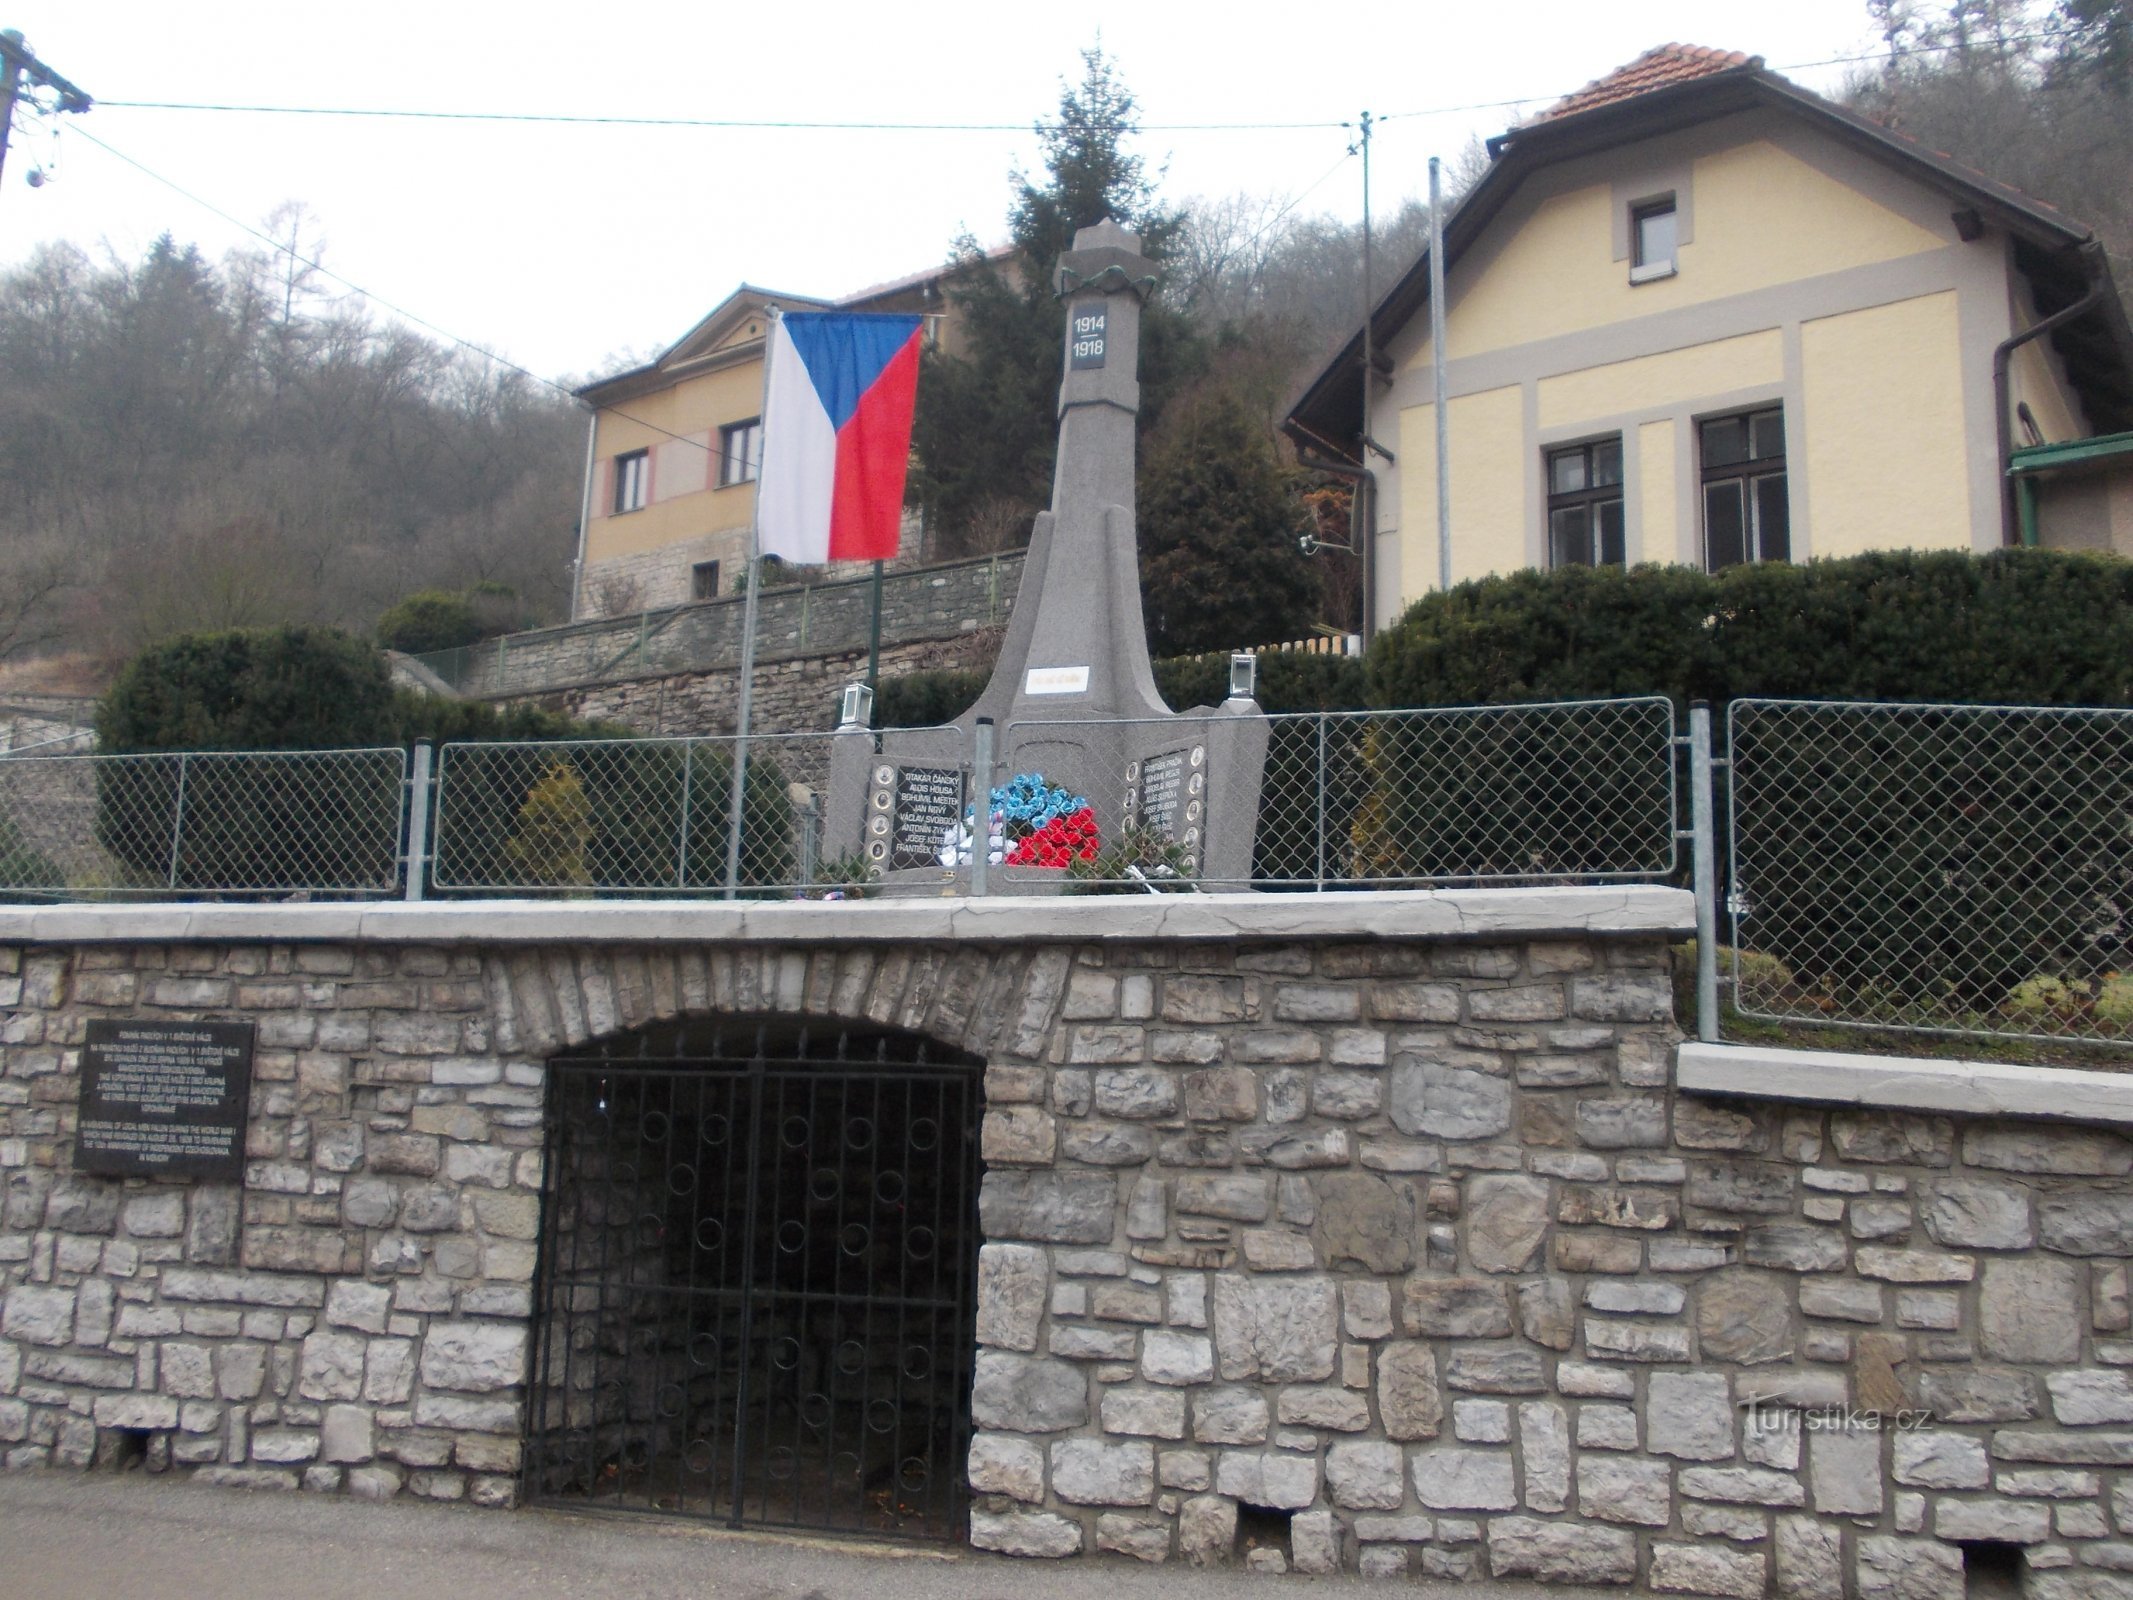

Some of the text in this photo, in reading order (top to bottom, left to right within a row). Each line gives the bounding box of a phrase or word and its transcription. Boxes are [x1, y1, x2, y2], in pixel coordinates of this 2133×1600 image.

[1074, 315, 1105, 333] 1914
[1073, 339, 1104, 357] 1918
[905, 772, 931, 782] OTAKAR
[909, 784, 929, 793] ALOIS
[901, 792, 932, 803] BOHUMIL
[912, 803, 947, 814] JAN NOVÝ
[900, 811, 958, 826] VÁCLAV SVOBODA
[905, 834, 926, 843] JOSEF
[896, 843, 932, 854] FRANTIŠEK
